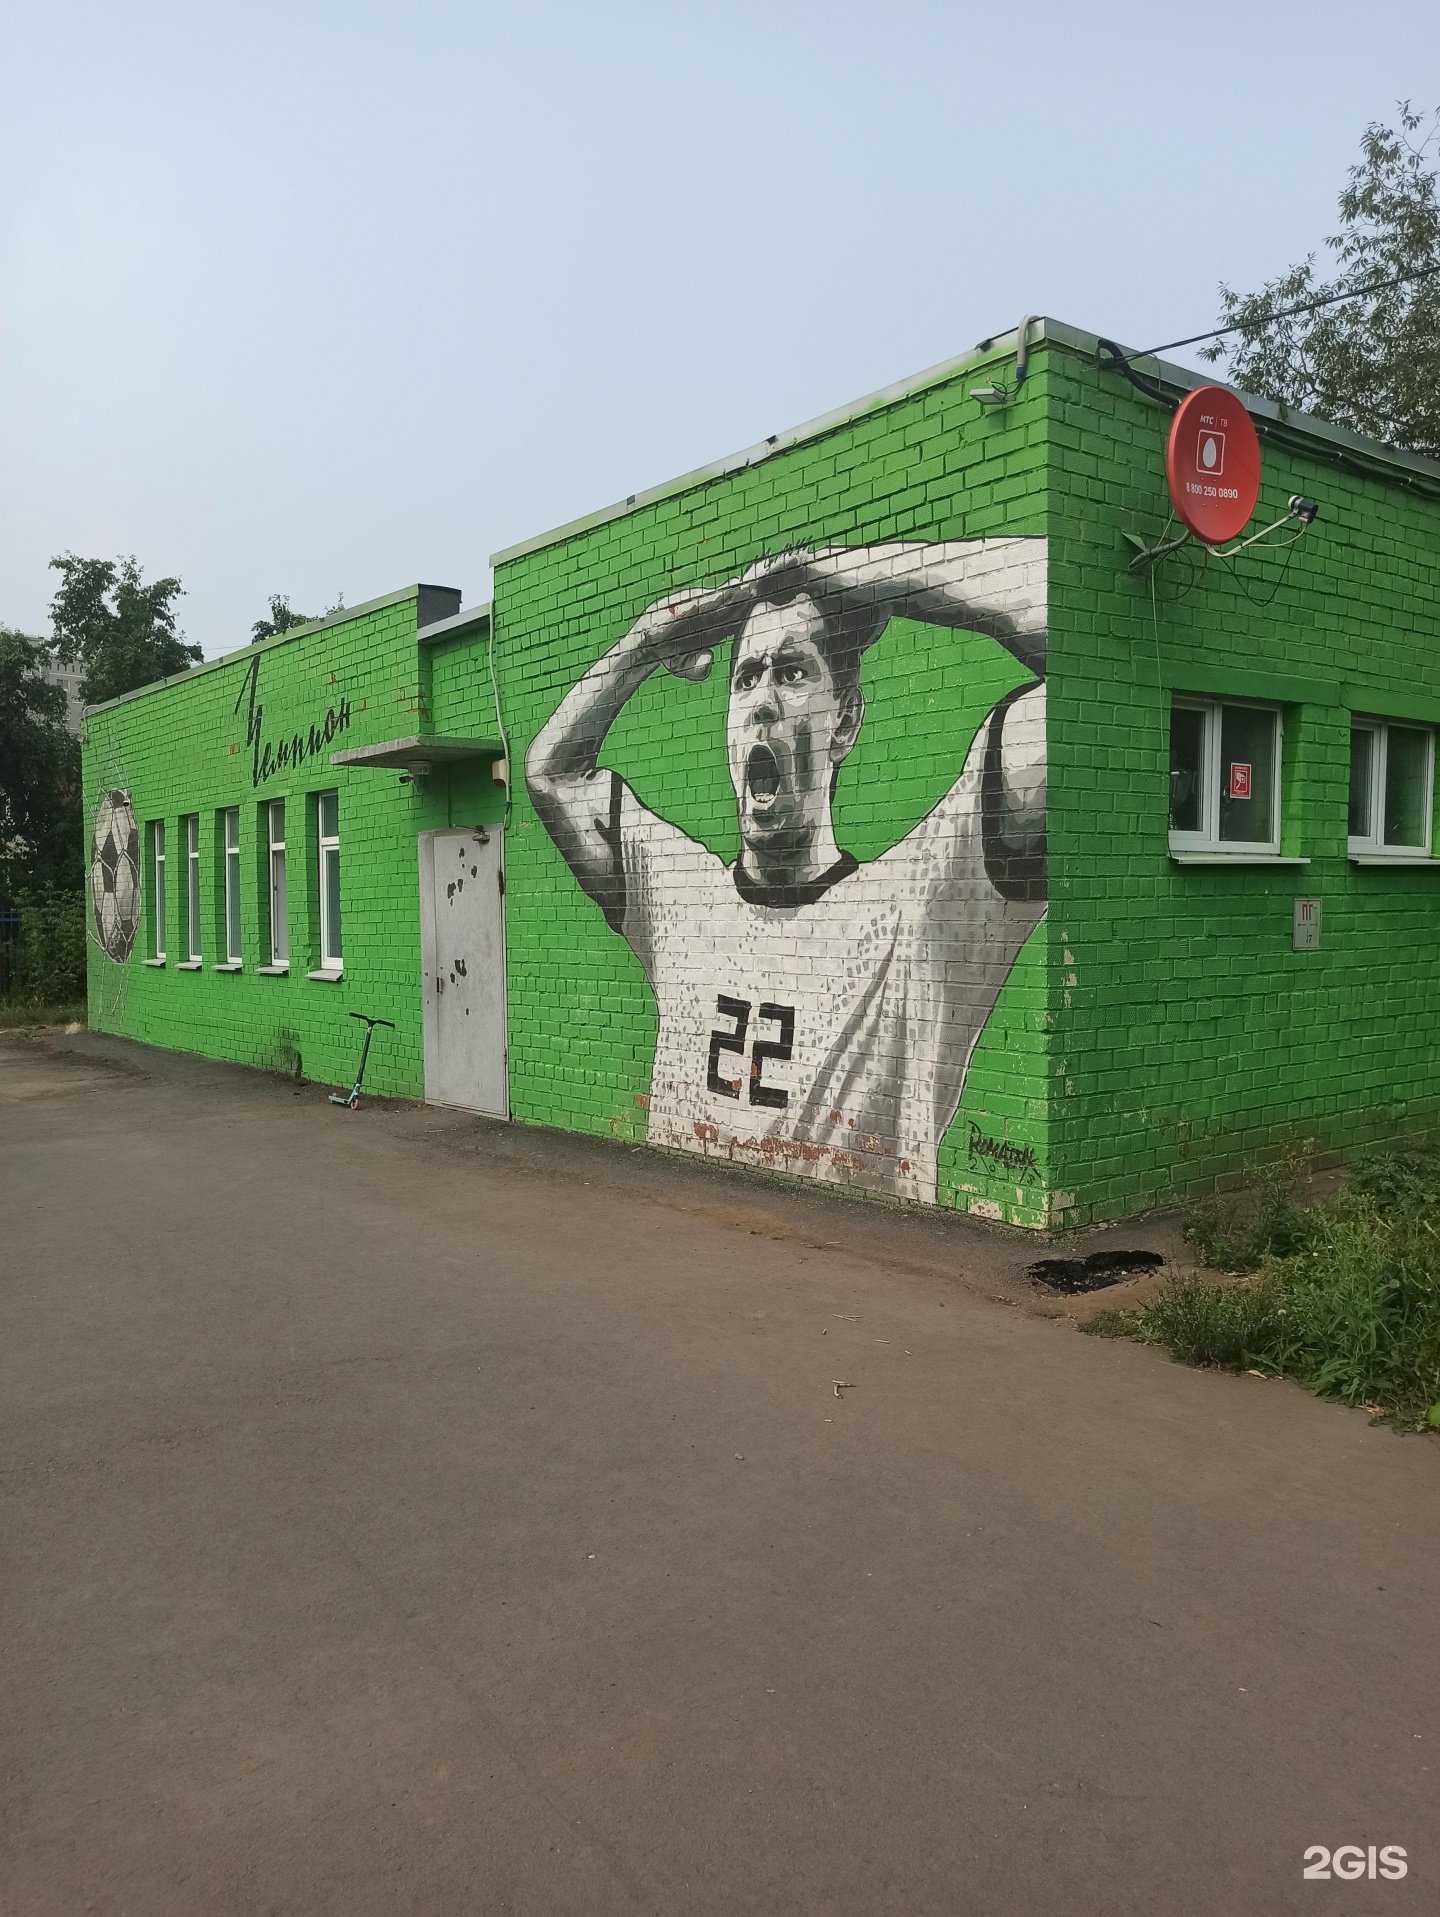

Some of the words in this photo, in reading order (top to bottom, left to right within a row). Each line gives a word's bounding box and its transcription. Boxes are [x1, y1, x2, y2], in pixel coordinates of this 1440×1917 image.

[1191, 484, 1203, 495] 800
[1203, 486, 1217, 497] 250
[1218, 488, 1238, 499] 0890
[234, 655, 352, 788] Чемпион
[1302, 904, 1313, 920] ПГ
[707, 993, 795, 1109] 22
